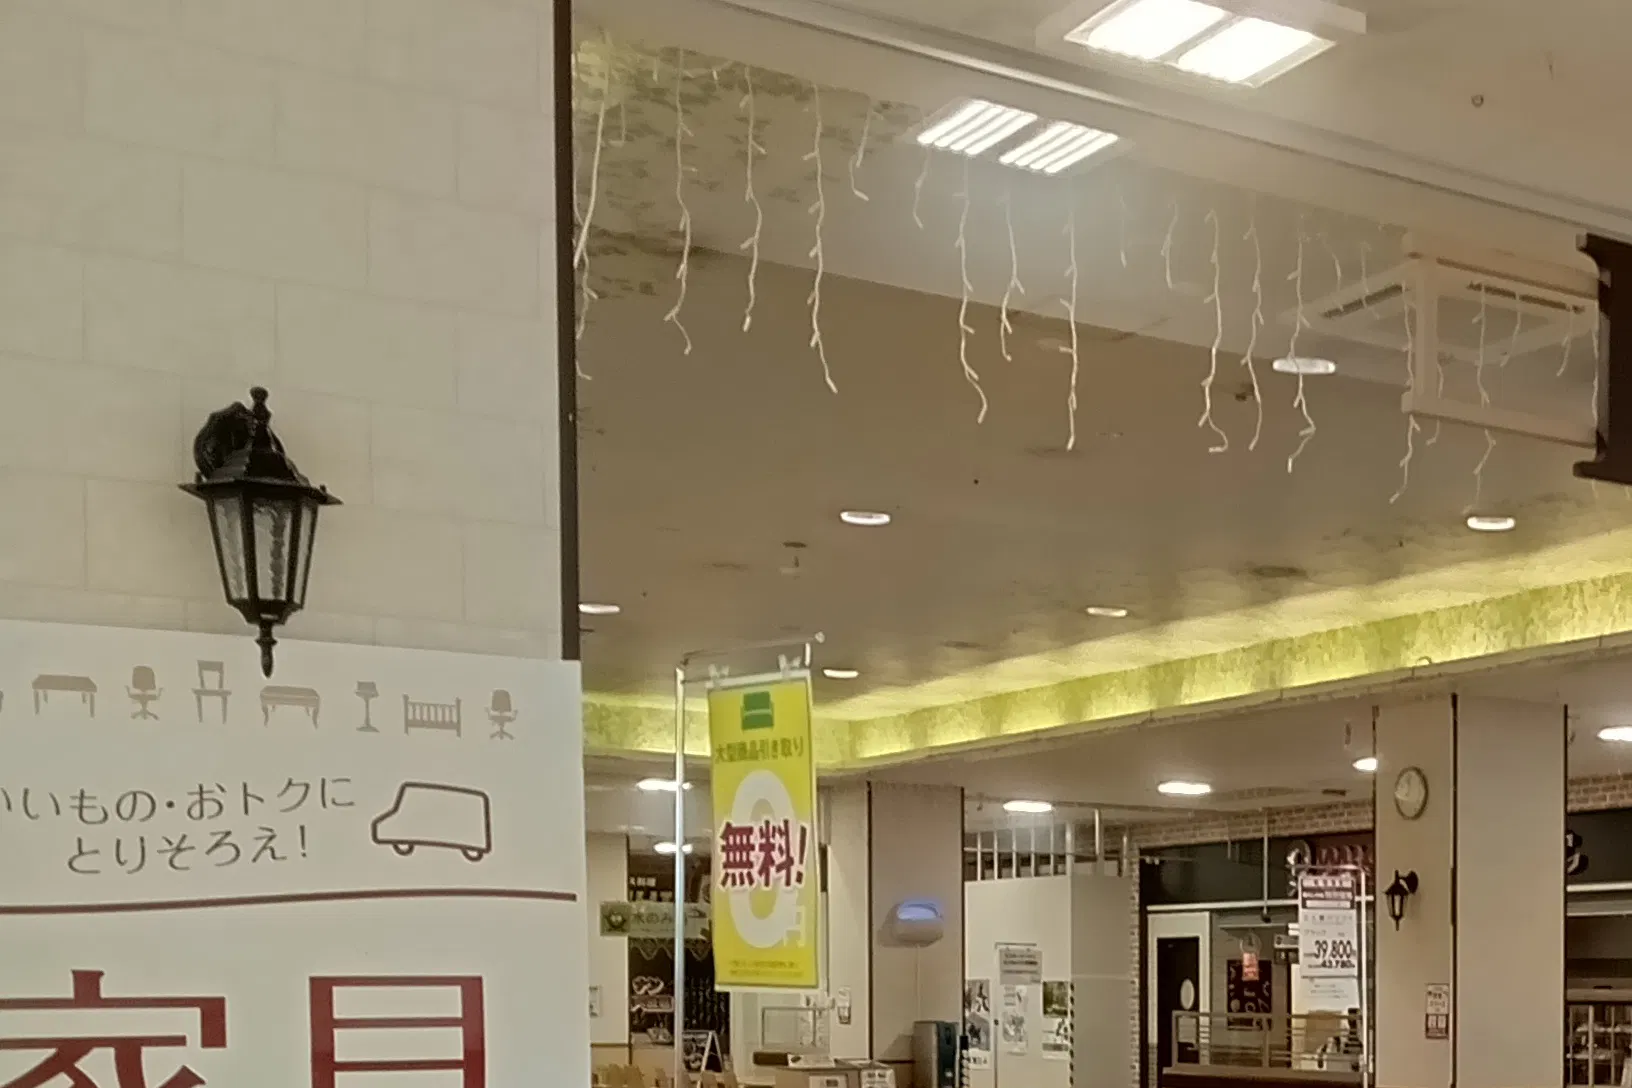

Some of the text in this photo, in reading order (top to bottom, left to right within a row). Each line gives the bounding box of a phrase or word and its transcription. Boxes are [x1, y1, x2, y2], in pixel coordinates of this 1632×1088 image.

[67, 824, 308, 874] とりそろえ！
[719, 818, 807, 888] 無料！
